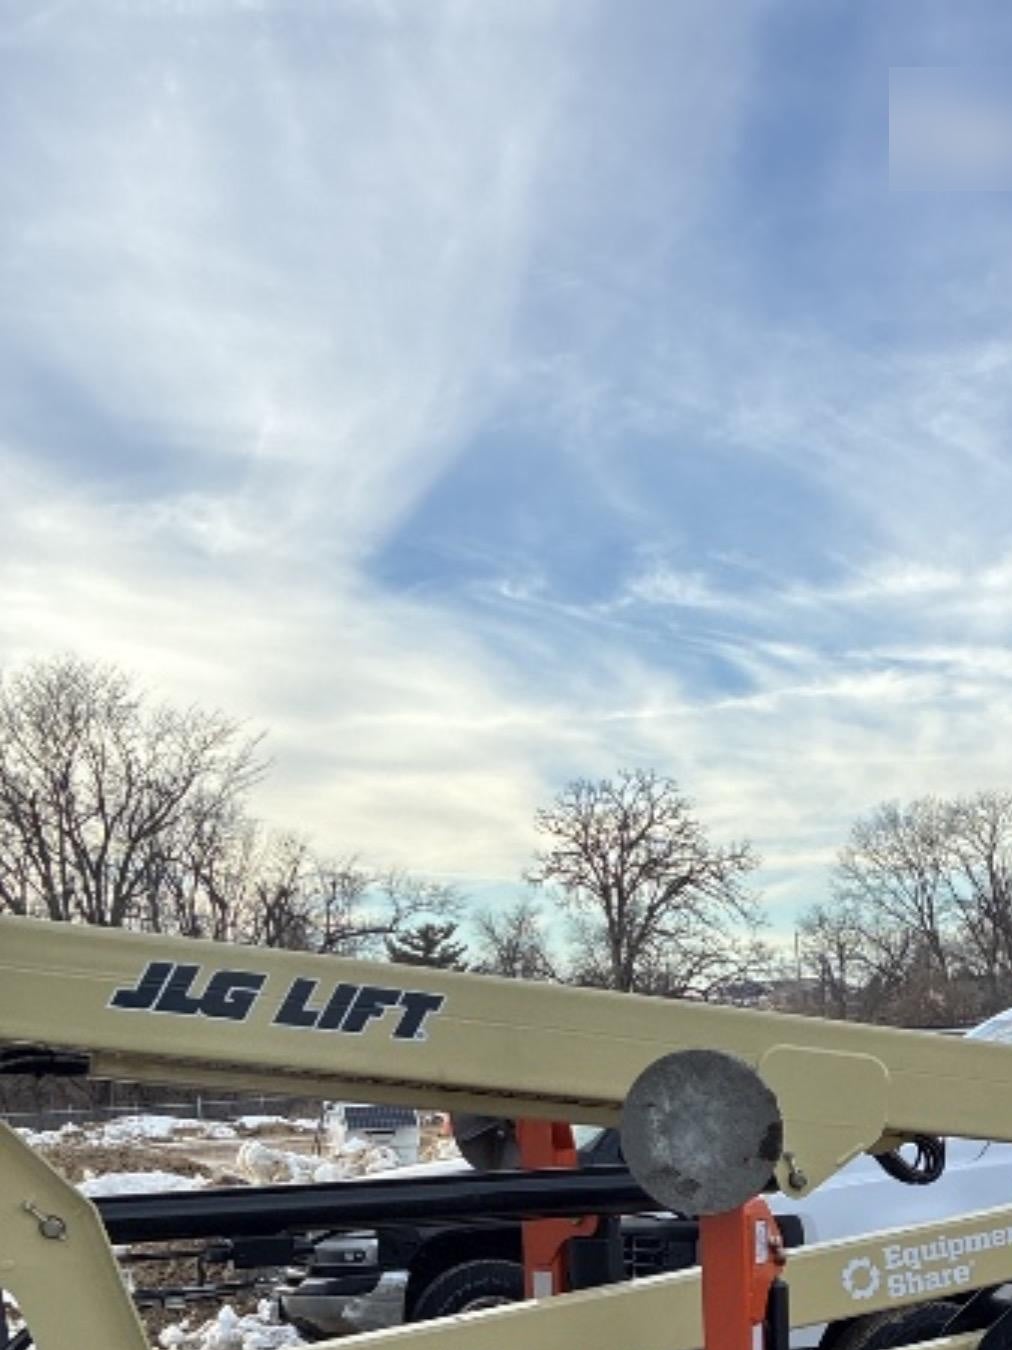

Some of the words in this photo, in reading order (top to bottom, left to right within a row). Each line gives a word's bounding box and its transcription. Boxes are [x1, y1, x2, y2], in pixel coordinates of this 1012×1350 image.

[107, 961, 267, 1022] JLG
[271, 977, 446, 1040] LIFT
[887, 1263, 972, 1297] Share
